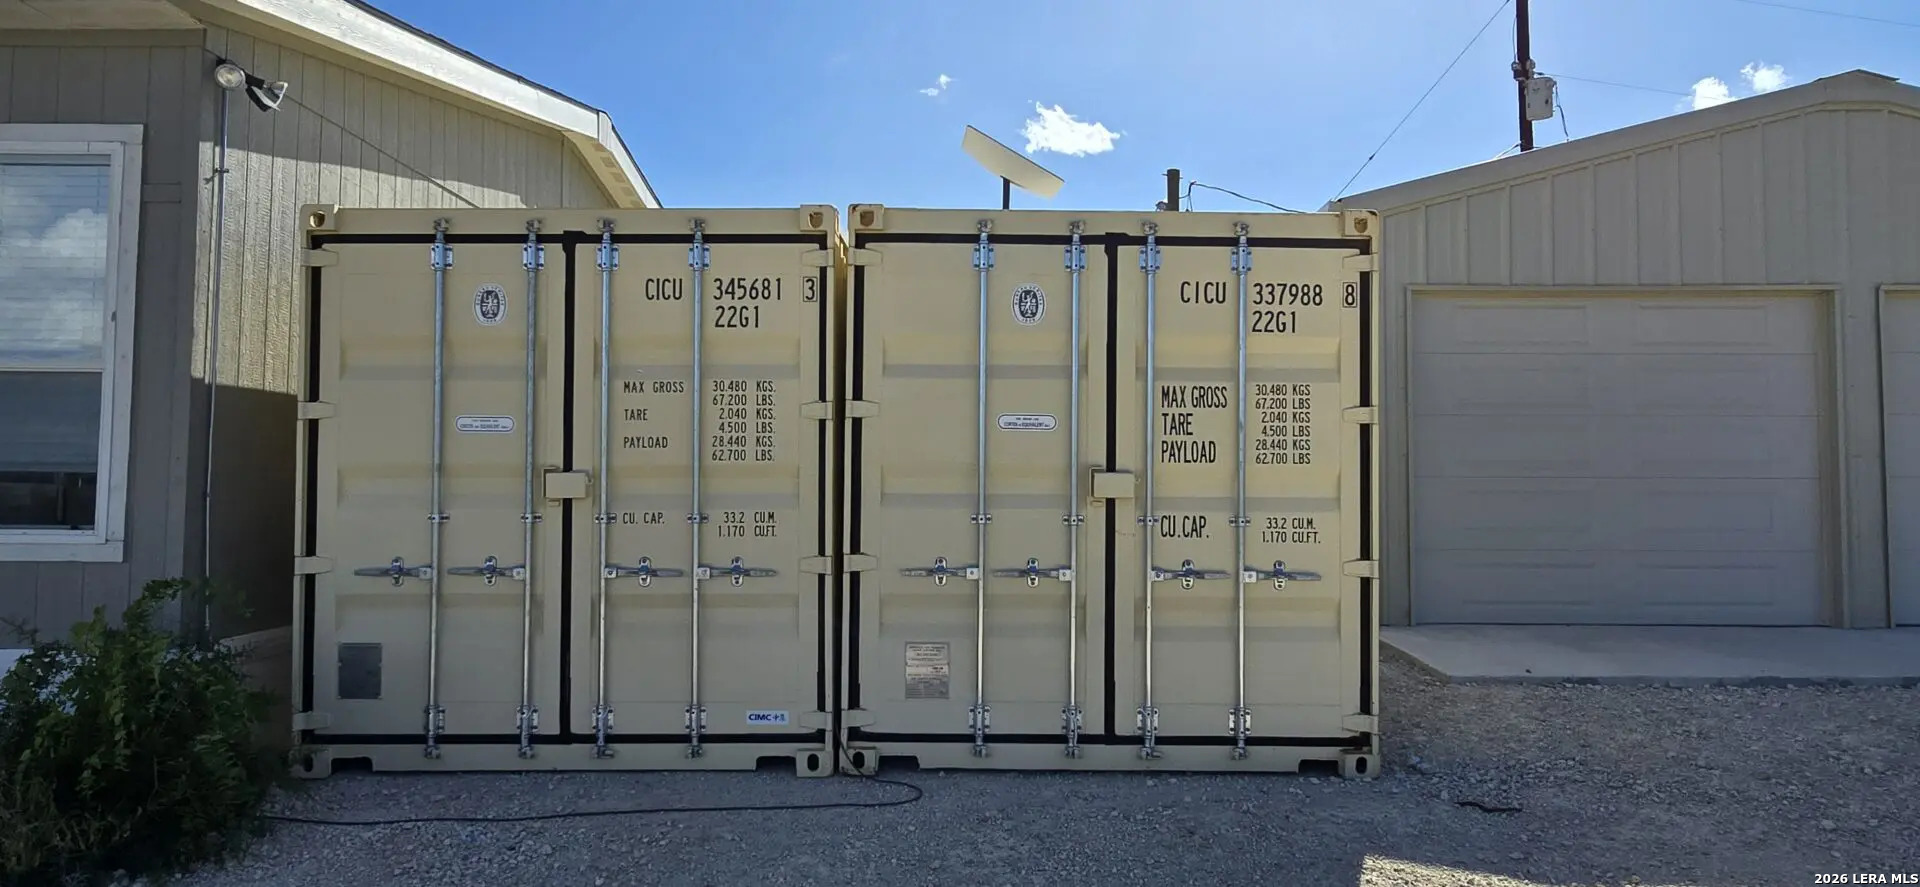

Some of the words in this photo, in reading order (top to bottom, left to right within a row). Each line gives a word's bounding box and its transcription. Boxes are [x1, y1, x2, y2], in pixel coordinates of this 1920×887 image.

[646, 278, 682, 300] CICU
[713, 278, 782, 300] 345681
[805, 279, 815, 300] 3
[1181, 281, 1226, 304] CICU
[1253, 283, 1322, 306] 337988
[1344, 284, 1356, 306] 8
[715, 306, 759, 328] 22G1
[1252, 311, 1296, 333] 22G1
[624, 381, 644, 393] MAX
[653, 381, 684, 393] GROSS
[713, 380, 747, 392] 30.480
[756, 381, 776, 392] KGS.
[1256, 384, 1287, 396] 30.480
[1293, 384, 1310, 396] KGS
[713, 394, 746, 405] 67.200
[756, 394, 775, 406] LBS.
[1162, 386, 1186, 408] MAX
[1191, 386, 1227, 408] GROSS
[1256, 398, 1287, 409] 67.200
[1293, 398, 1310, 409] LBS
[625, 409, 648, 420] TARE
[719, 408, 746, 419] 2.040
[756, 408, 776, 420] KGS.
[1262, 412, 1287, 423] 2.040
[1293, 412, 1310, 423] KGS
[719, 422, 746, 433] 4.500
[756, 422, 775, 433] LBS.
[1162, 413, 1193, 435] TARE
[1262, 425, 1287, 437] 4.500
[1293, 425, 1310, 437] LBS
[624, 437, 668, 448] PAYLOAD
[712, 435, 746, 447] 28.440
[756, 436, 775, 447] KGS.
[1256, 439, 1287, 450] 28.440
[1293, 439, 1310, 450] KGS
[712, 449, 746, 461] 62.700
[756, 449, 774, 461] LBS.
[1162, 440, 1216, 463] PAYLOAD
[1256, 453, 1287, 464] 62.700
[1293, 453, 1310, 464] LBS
[623, 512, 638, 524] CU.
[644, 512, 664, 524] CAP.
[724, 512, 745, 523] 33.2
[754, 512, 776, 523] CU.M.
[1266, 517, 1287, 529] 33.2
[1292, 518, 1315, 529] CU.M.
[719, 525, 745, 537] 1.170
[755, 525, 776, 536] CU.FT.
[1263, 531, 1287, 543] 1.170
[1292, 532, 1320, 543] CU.FT.
[748, 713, 771, 721] CIMC
